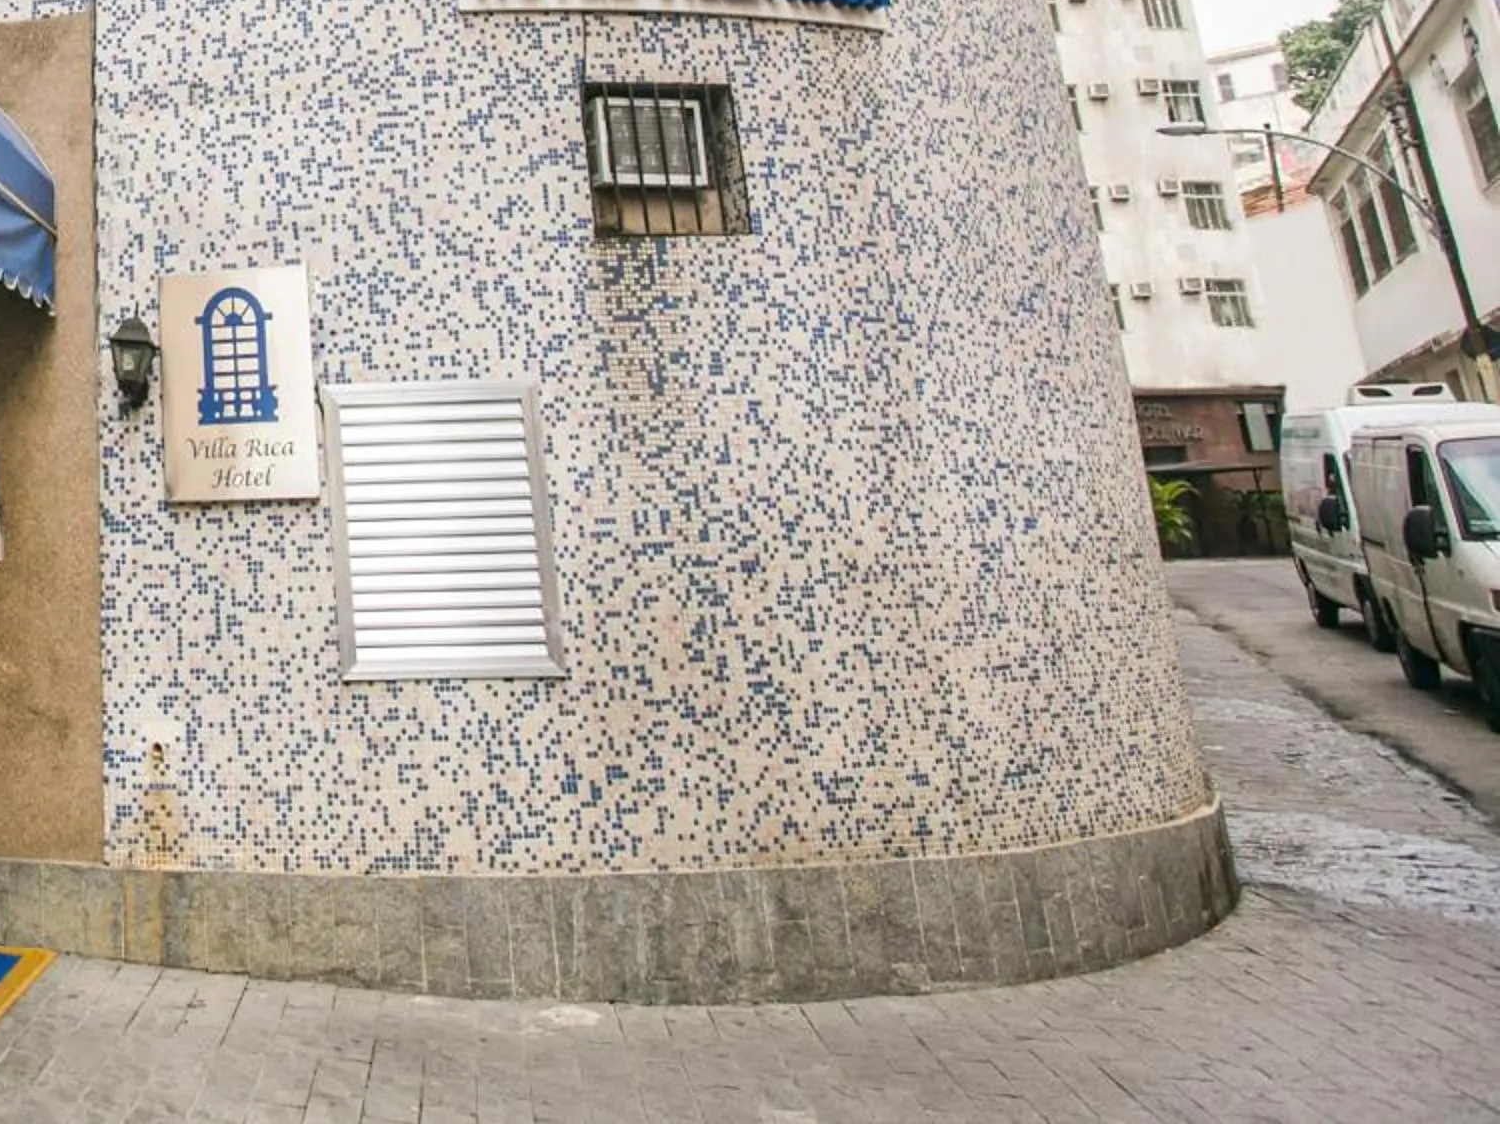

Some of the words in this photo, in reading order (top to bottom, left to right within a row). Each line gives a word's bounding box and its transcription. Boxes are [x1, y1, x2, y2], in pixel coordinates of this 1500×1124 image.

[187, 436, 237, 461] Villa
[241, 437, 295, 459] Rica
[211, 464, 275, 490] Hotel
